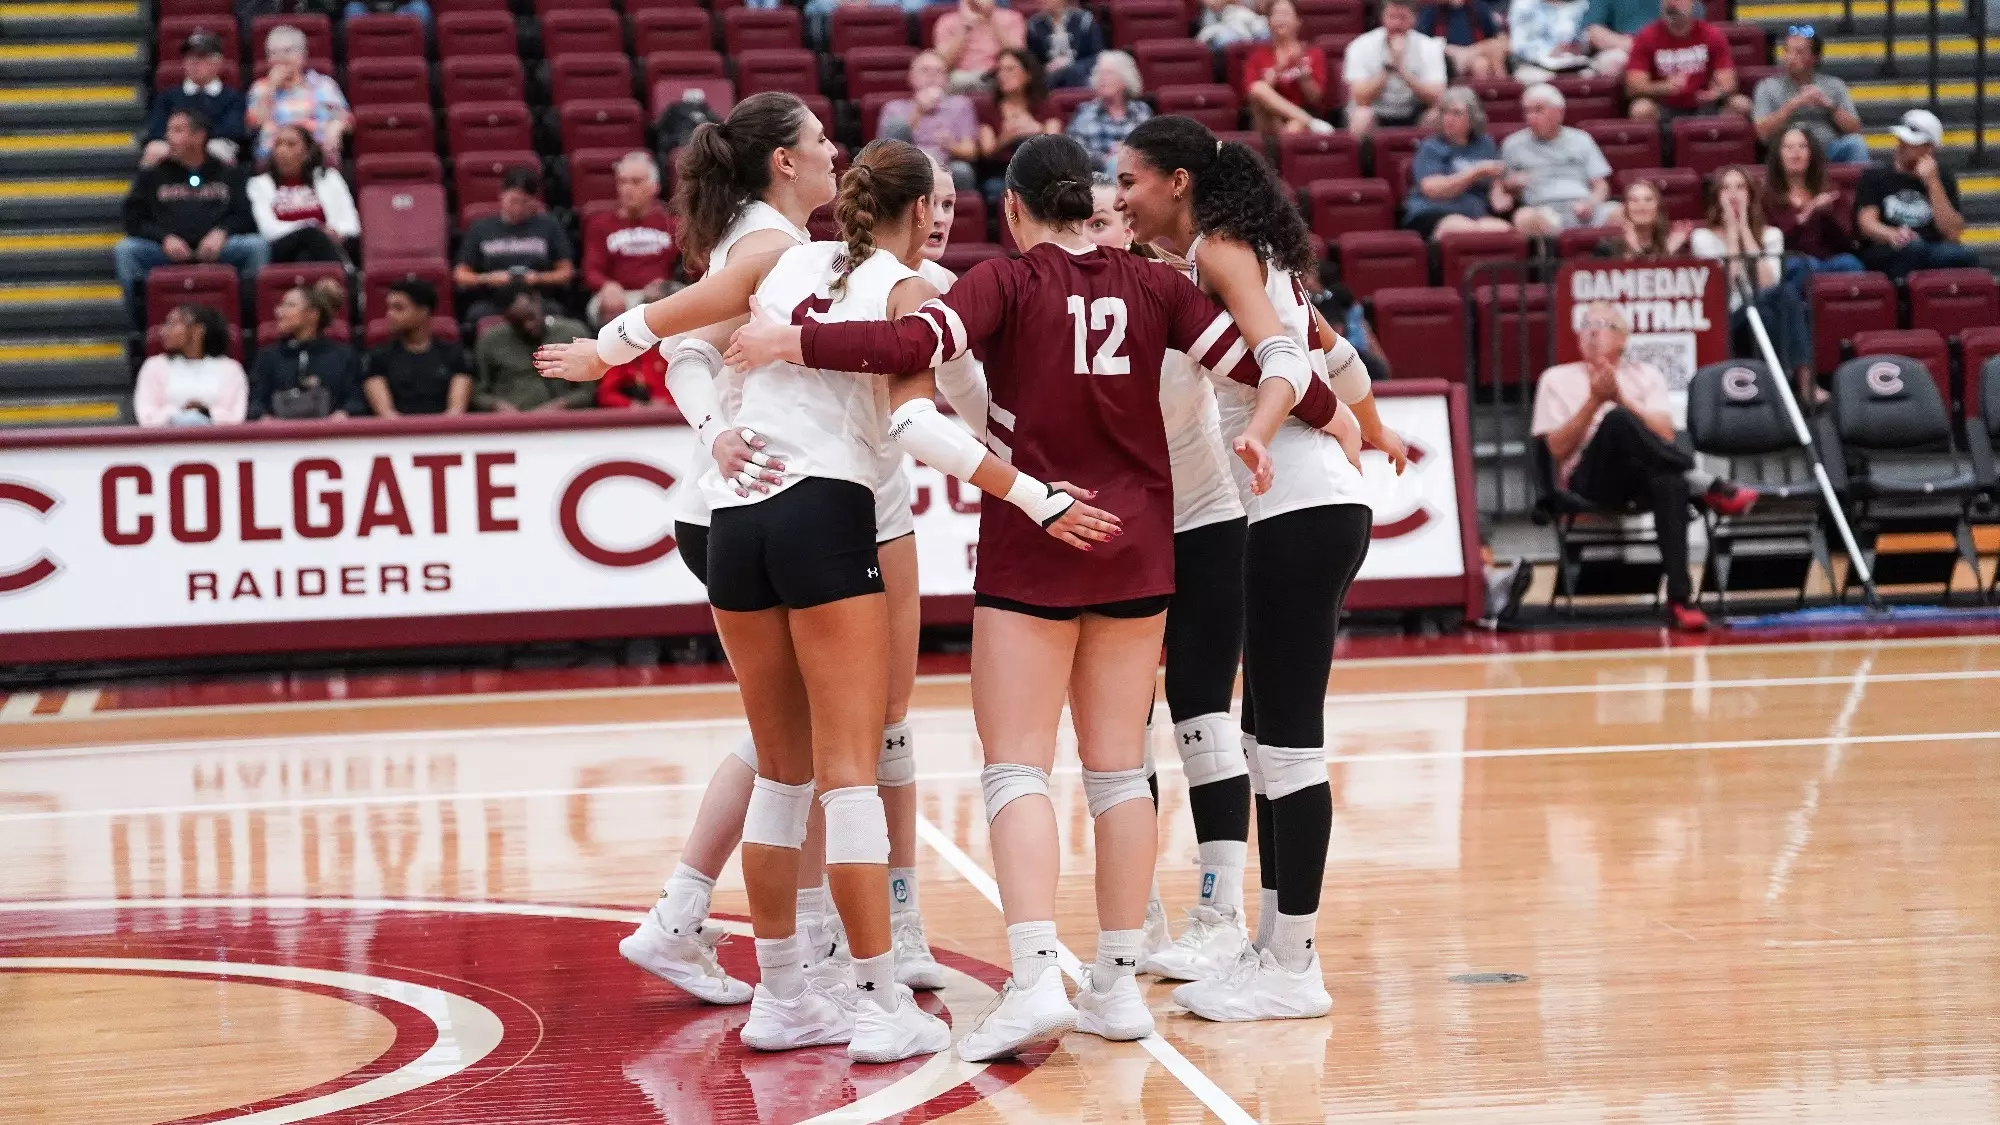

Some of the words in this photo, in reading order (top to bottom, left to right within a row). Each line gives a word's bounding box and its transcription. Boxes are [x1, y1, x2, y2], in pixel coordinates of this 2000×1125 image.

[1571, 266, 1710, 300] GAMEDAY
[1571, 300, 1711, 333] CNTRAL
[1066, 294, 1131, 376] 12
[1721, 366, 1759, 400] C
[1866, 361, 1904, 396] C
[101, 452, 519, 546] COLGATE
[558, 460, 678, 568] C
[188, 563, 452, 601] RAIDERS
